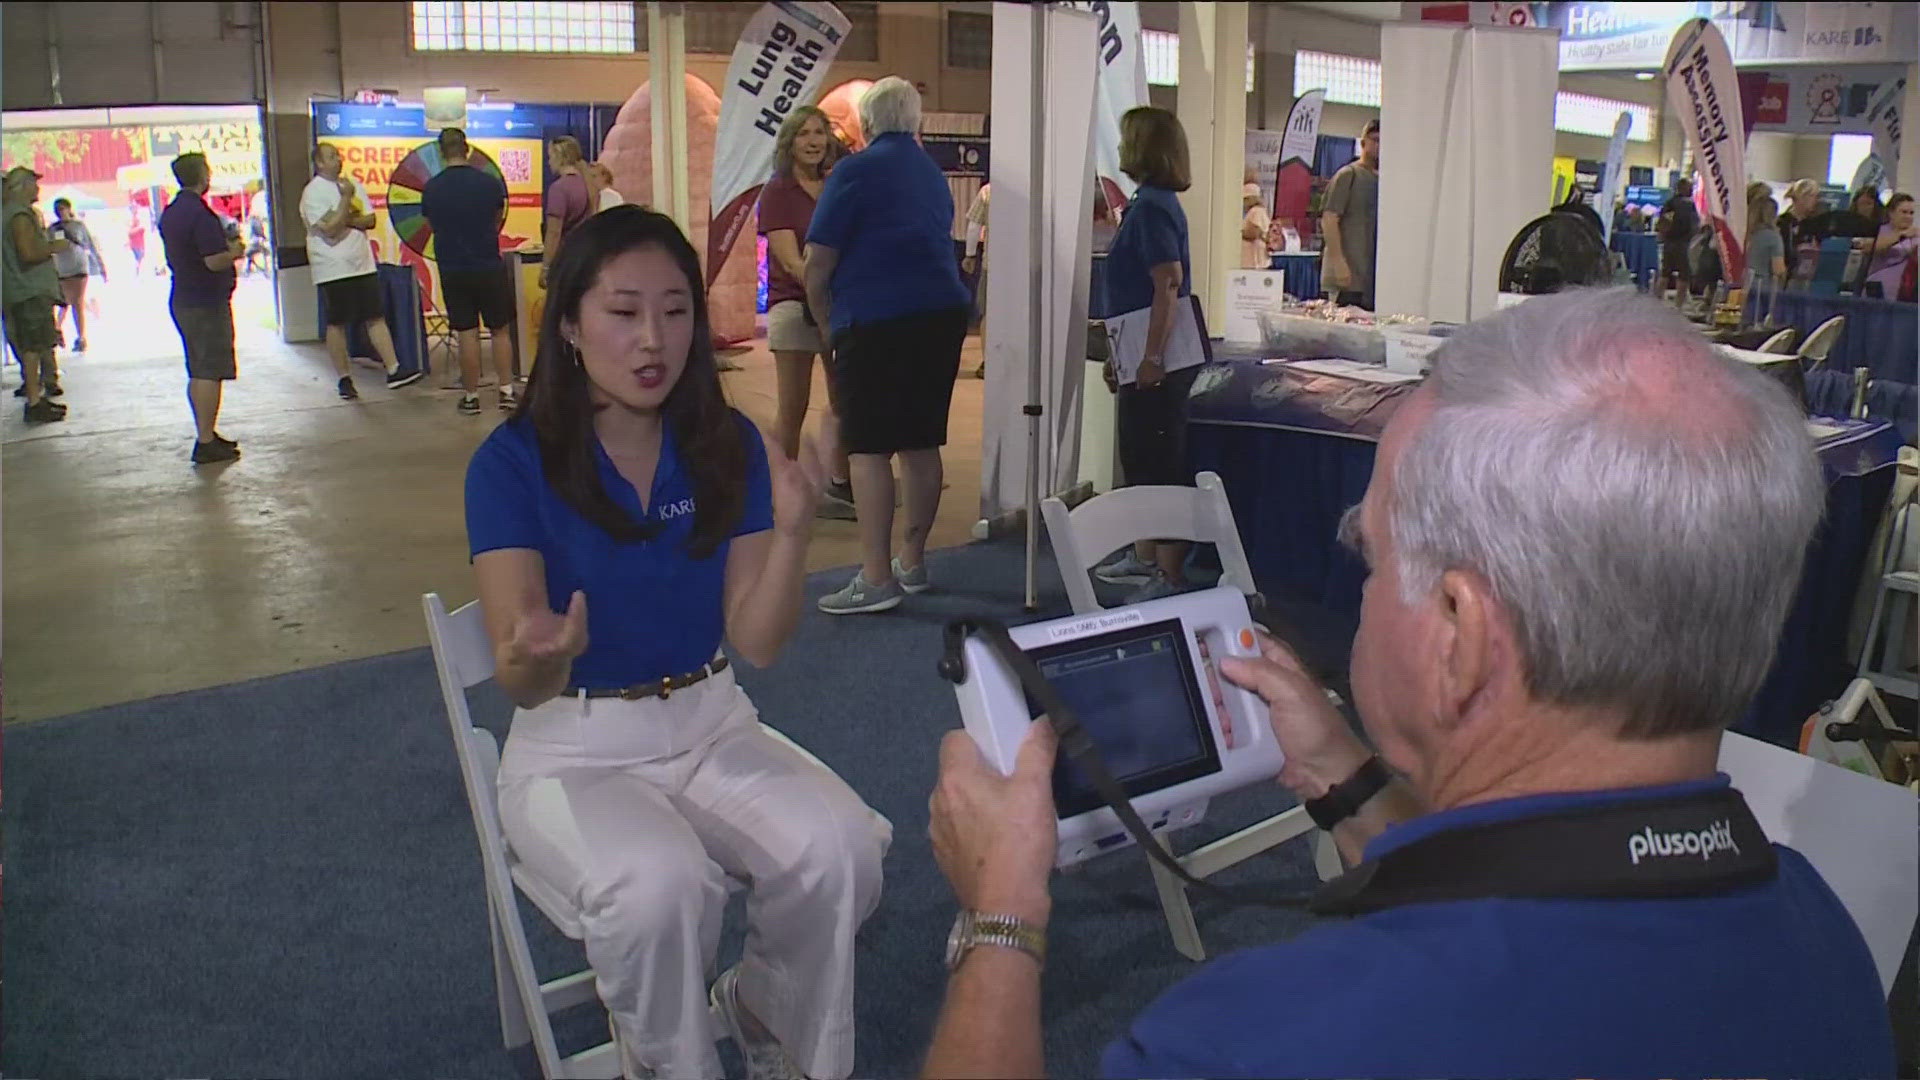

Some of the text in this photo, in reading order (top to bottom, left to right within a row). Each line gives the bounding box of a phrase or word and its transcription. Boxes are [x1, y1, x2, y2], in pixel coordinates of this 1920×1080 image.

[738, 21, 797, 96] Lung
[1806, 30, 1850, 46] KARE
[754, 39, 824, 137] Health
[1692, 45, 1728, 143] Memory
[336, 146, 410, 164] SCREE
[1679, 63, 1731, 216] Assessments
[352, 167, 394, 185] SAV
[1629, 818, 1740, 864] plusoptix
